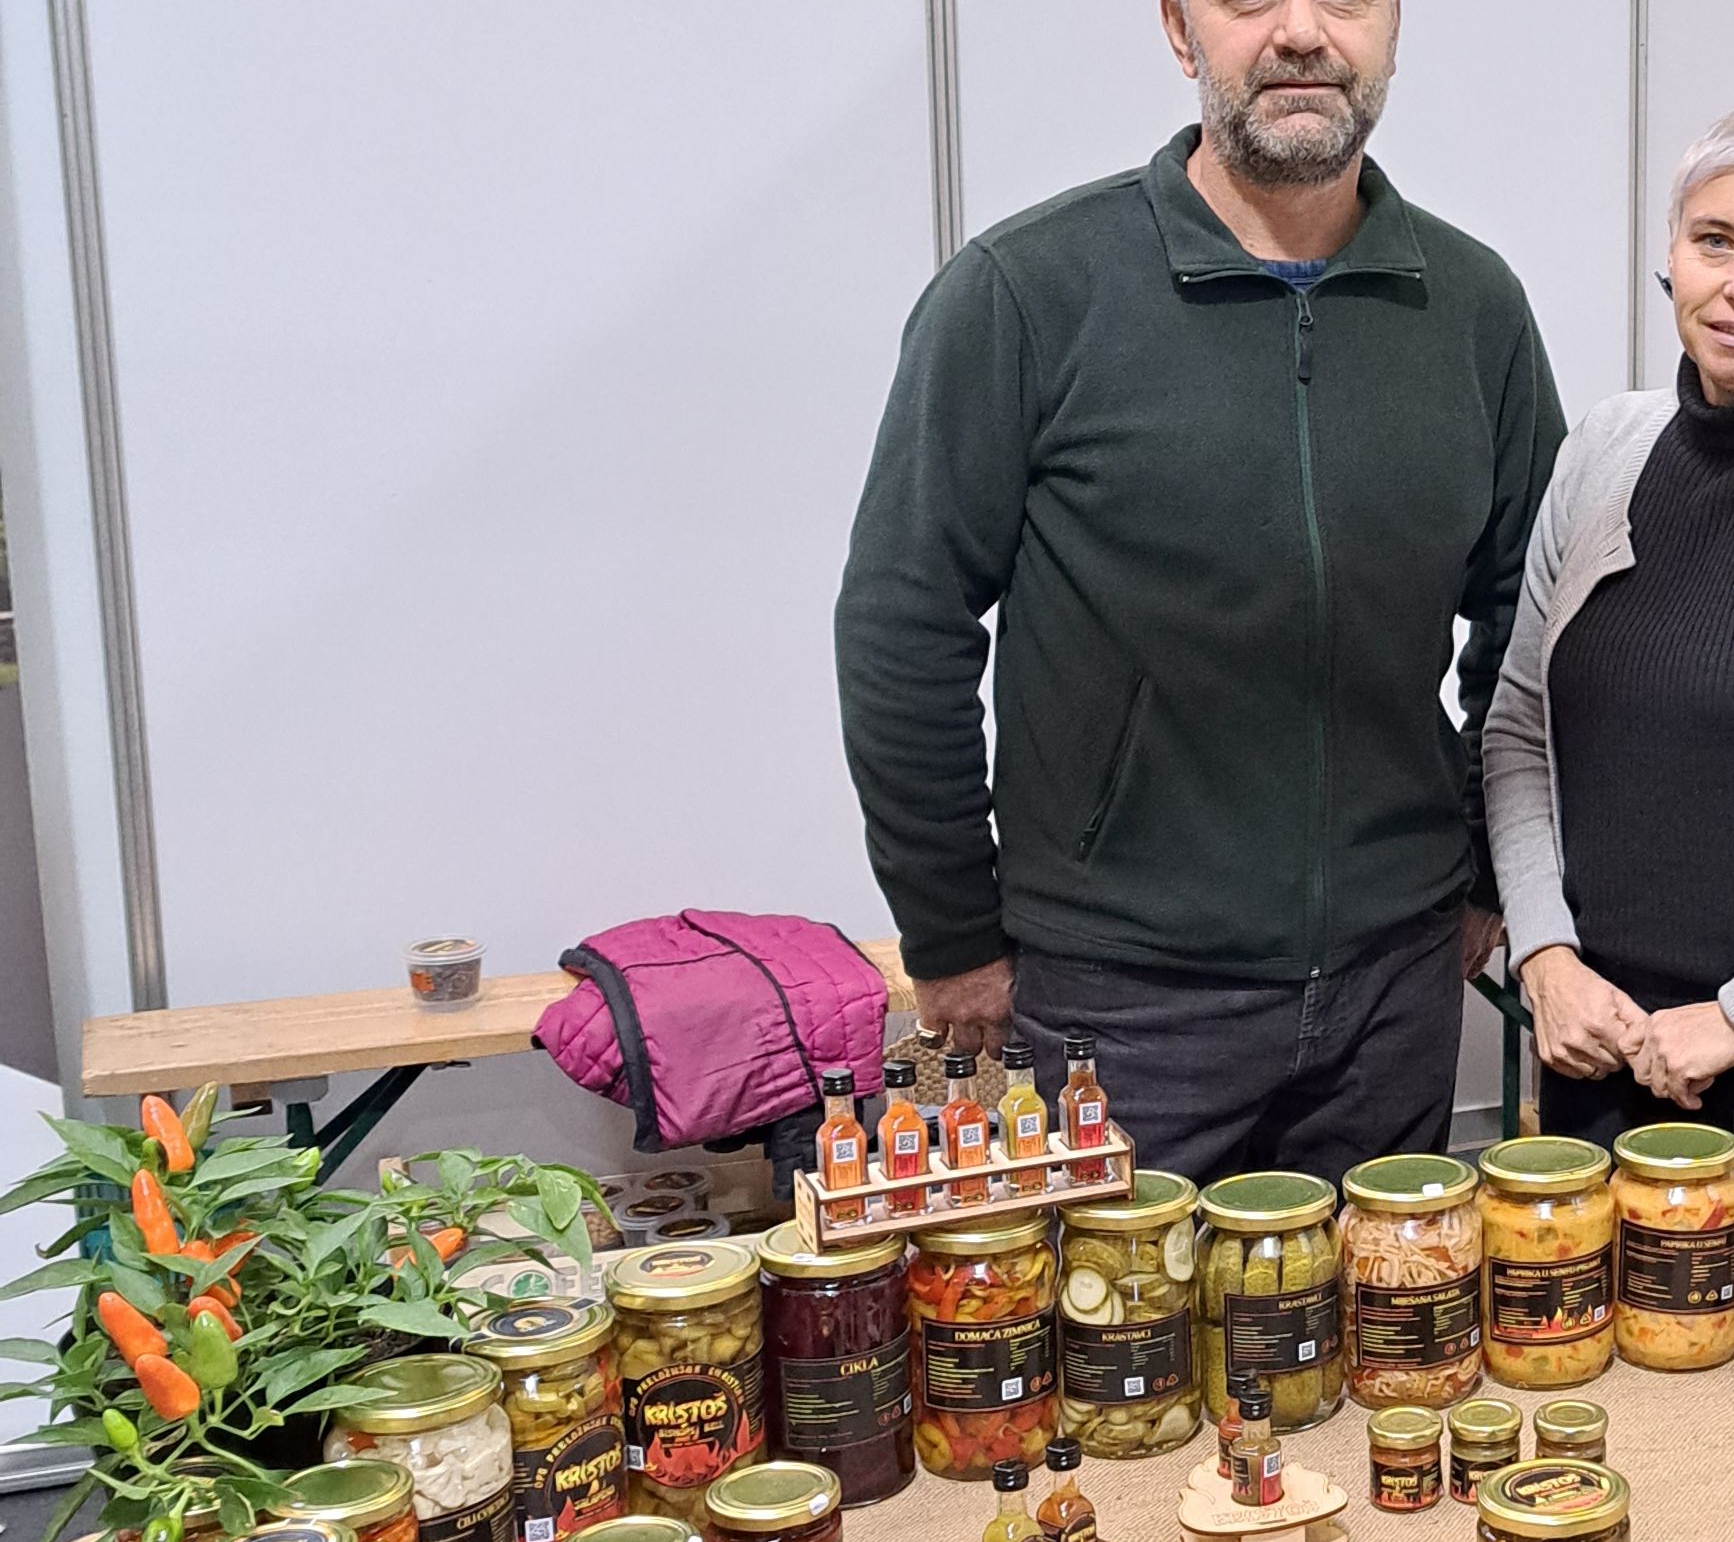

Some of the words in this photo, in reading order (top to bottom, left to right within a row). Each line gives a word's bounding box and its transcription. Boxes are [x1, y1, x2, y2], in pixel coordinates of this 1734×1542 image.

[840, 1356, 879, 1376] CIKLA
[643, 1391, 728, 1427] KRISTOŠ
[555, 1440, 622, 1493] KRISTOŠ
